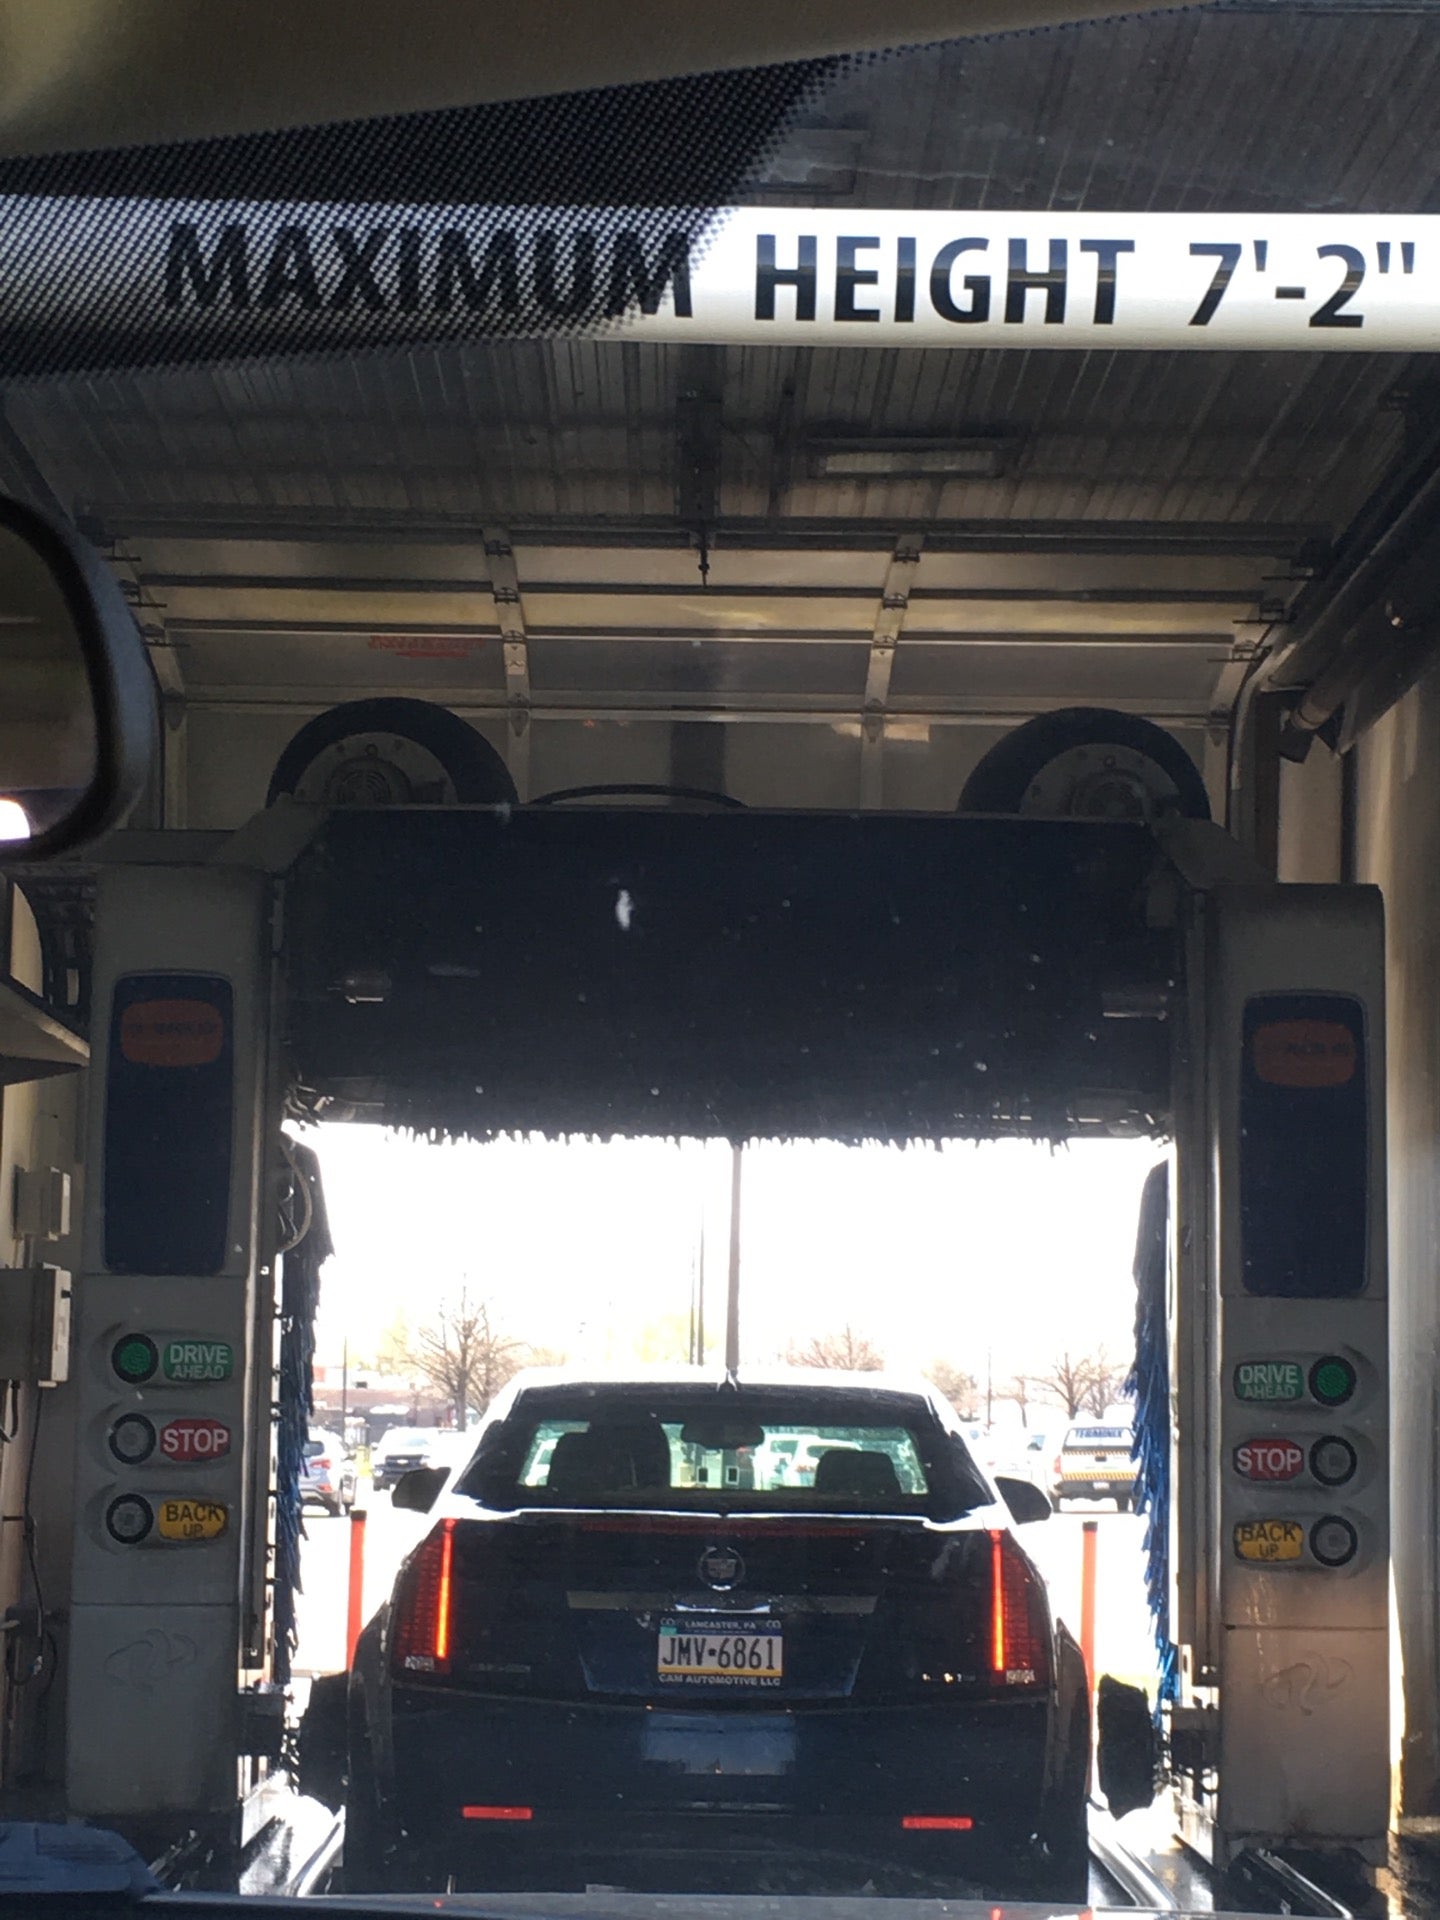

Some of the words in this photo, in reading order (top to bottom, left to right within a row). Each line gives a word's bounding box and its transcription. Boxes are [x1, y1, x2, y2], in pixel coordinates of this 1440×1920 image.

[165, 221, 694, 318] MAXIMUM
[754, 234, 1135, 325] HEIGHT
[1188, 239, 1416, 328] 7'-2"
[170, 1344, 228, 1364] DRIVE
[171, 1364, 225, 1379] AHEAD
[1240, 1364, 1298, 1384] DRIVE
[1243, 1384, 1296, 1399] AHEAD
[163, 1429, 229, 1453] STOP
[1236, 1448, 1302, 1472] STOP
[166, 1504, 222, 1522] BACK
[183, 1523, 204, 1537] UP
[1241, 1524, 1297, 1542] BACK
[1258, 1543, 1280, 1558] UP
[659, 1673, 684, 1684] CAM
[686, 1675, 759, 1686] AUTOMOTIVE
[760, 1677, 781, 1686] LLC
